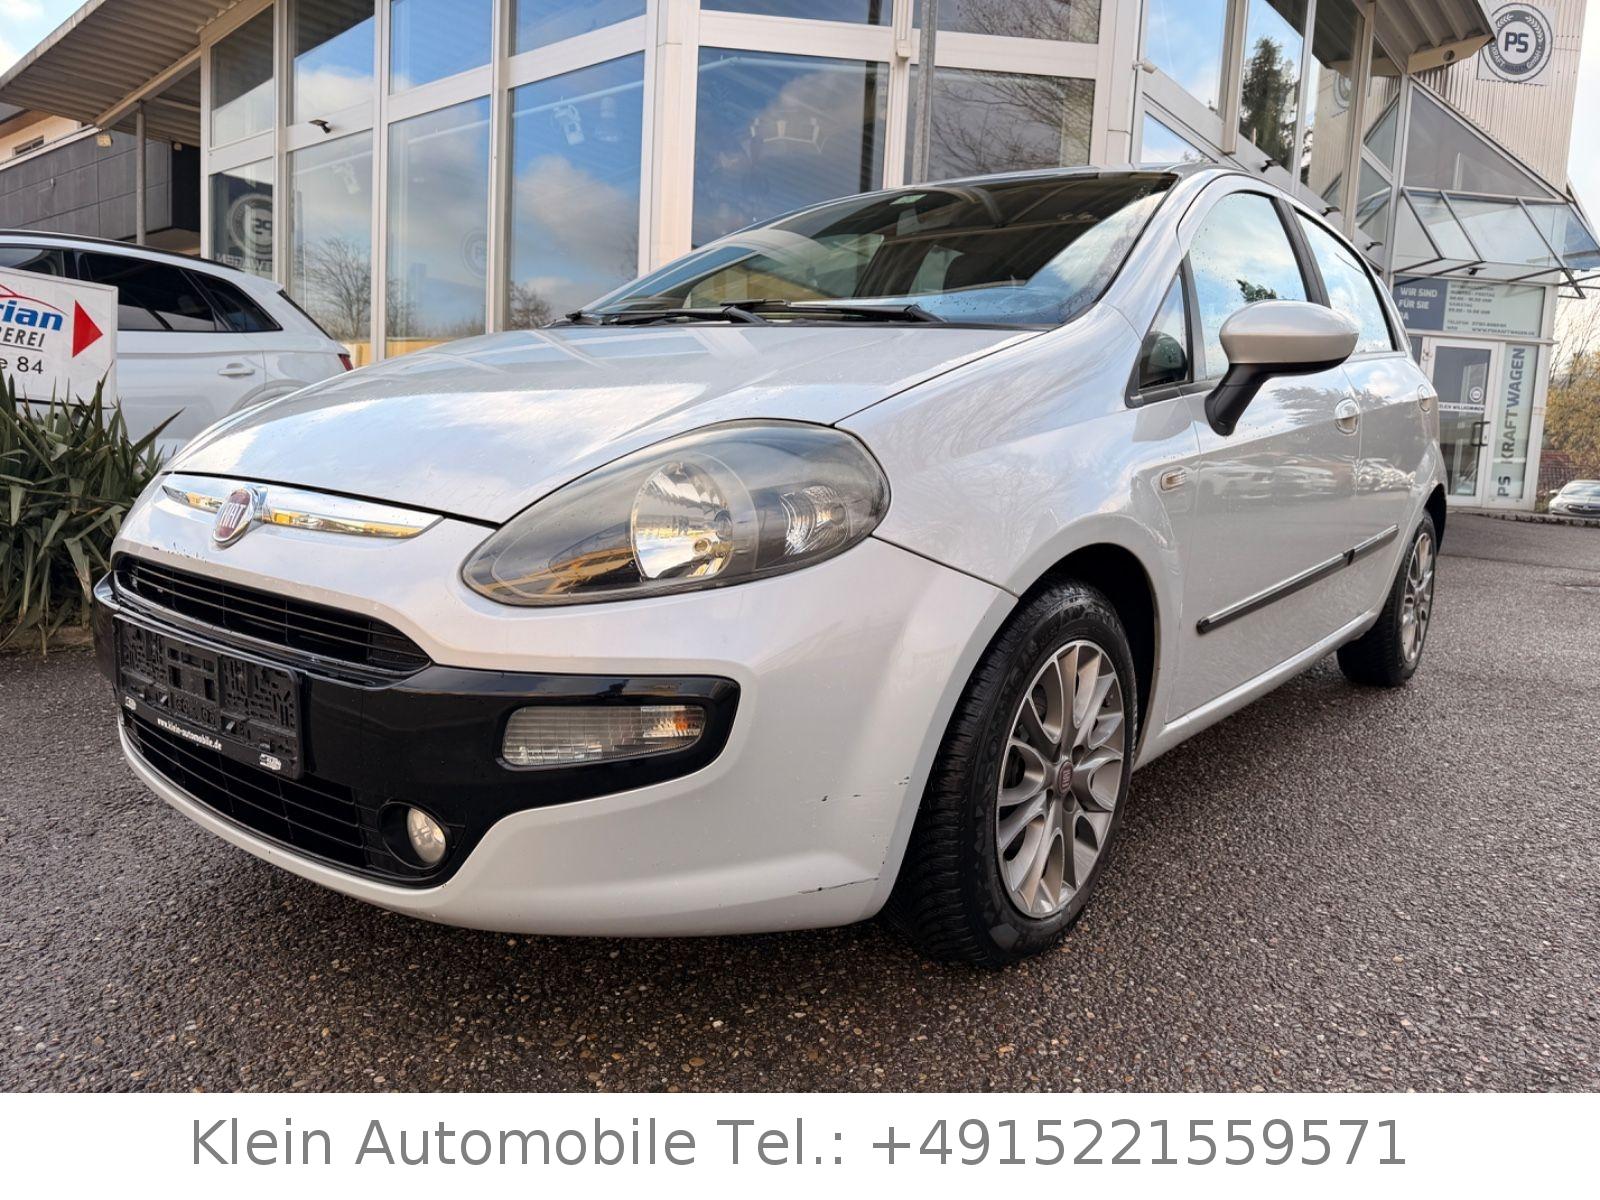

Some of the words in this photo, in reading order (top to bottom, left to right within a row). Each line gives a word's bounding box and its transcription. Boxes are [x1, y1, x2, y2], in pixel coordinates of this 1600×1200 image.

[1504, 32, 1529, 53] PS
[1400, 287, 1416, 296] WIR
[1418, 288, 1438, 298] SIND
[1398, 297, 1415, 309] FÜR
[1416, 301, 1430, 310] SIE
[17, 356, 44, 374] 84
[1500, 347, 1526, 465] KRAFTWAGEN
[1497, 475, 1511, 497] PS
